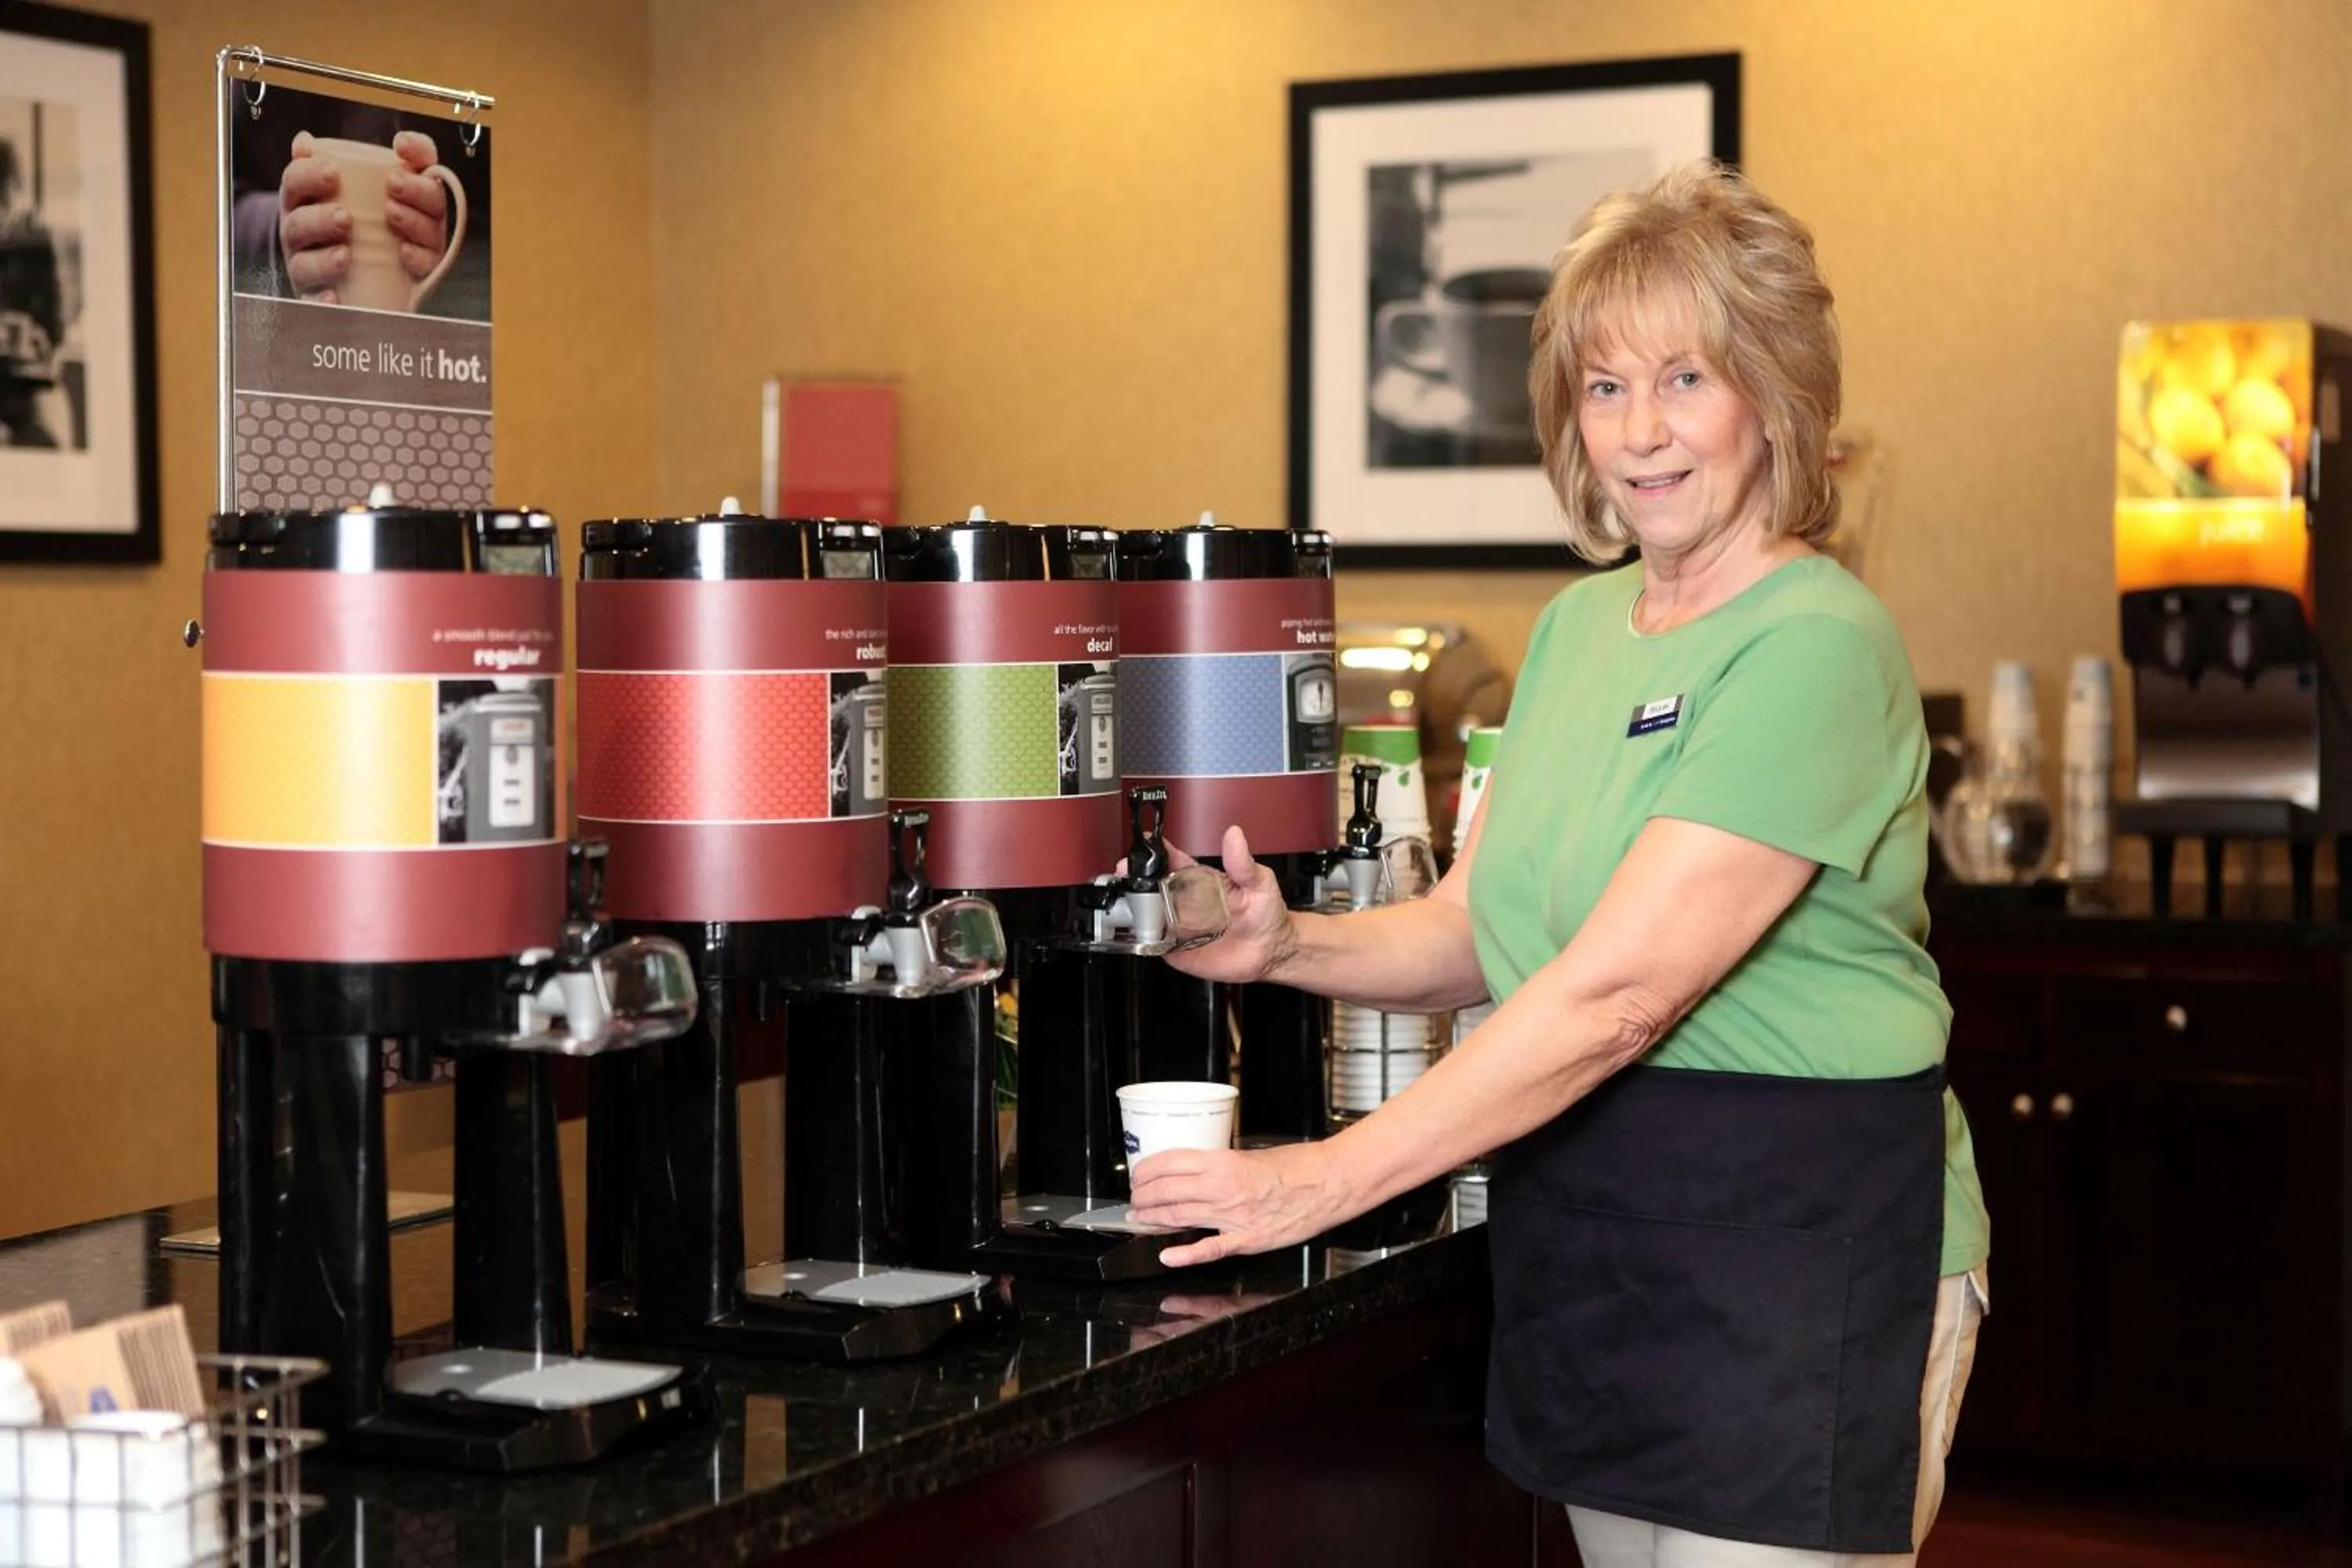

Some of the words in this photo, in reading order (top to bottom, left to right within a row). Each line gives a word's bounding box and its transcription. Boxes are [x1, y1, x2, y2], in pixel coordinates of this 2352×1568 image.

[313, 343, 371, 372] some
[378, 342, 413, 376] like
[420, 347, 434, 379] it
[438, 349, 487, 383] hot.
[825, 628, 839, 640] the
[840, 628, 855, 640] rich
[1297, 630, 1317, 644] hot
[473, 644, 542, 670] regular
